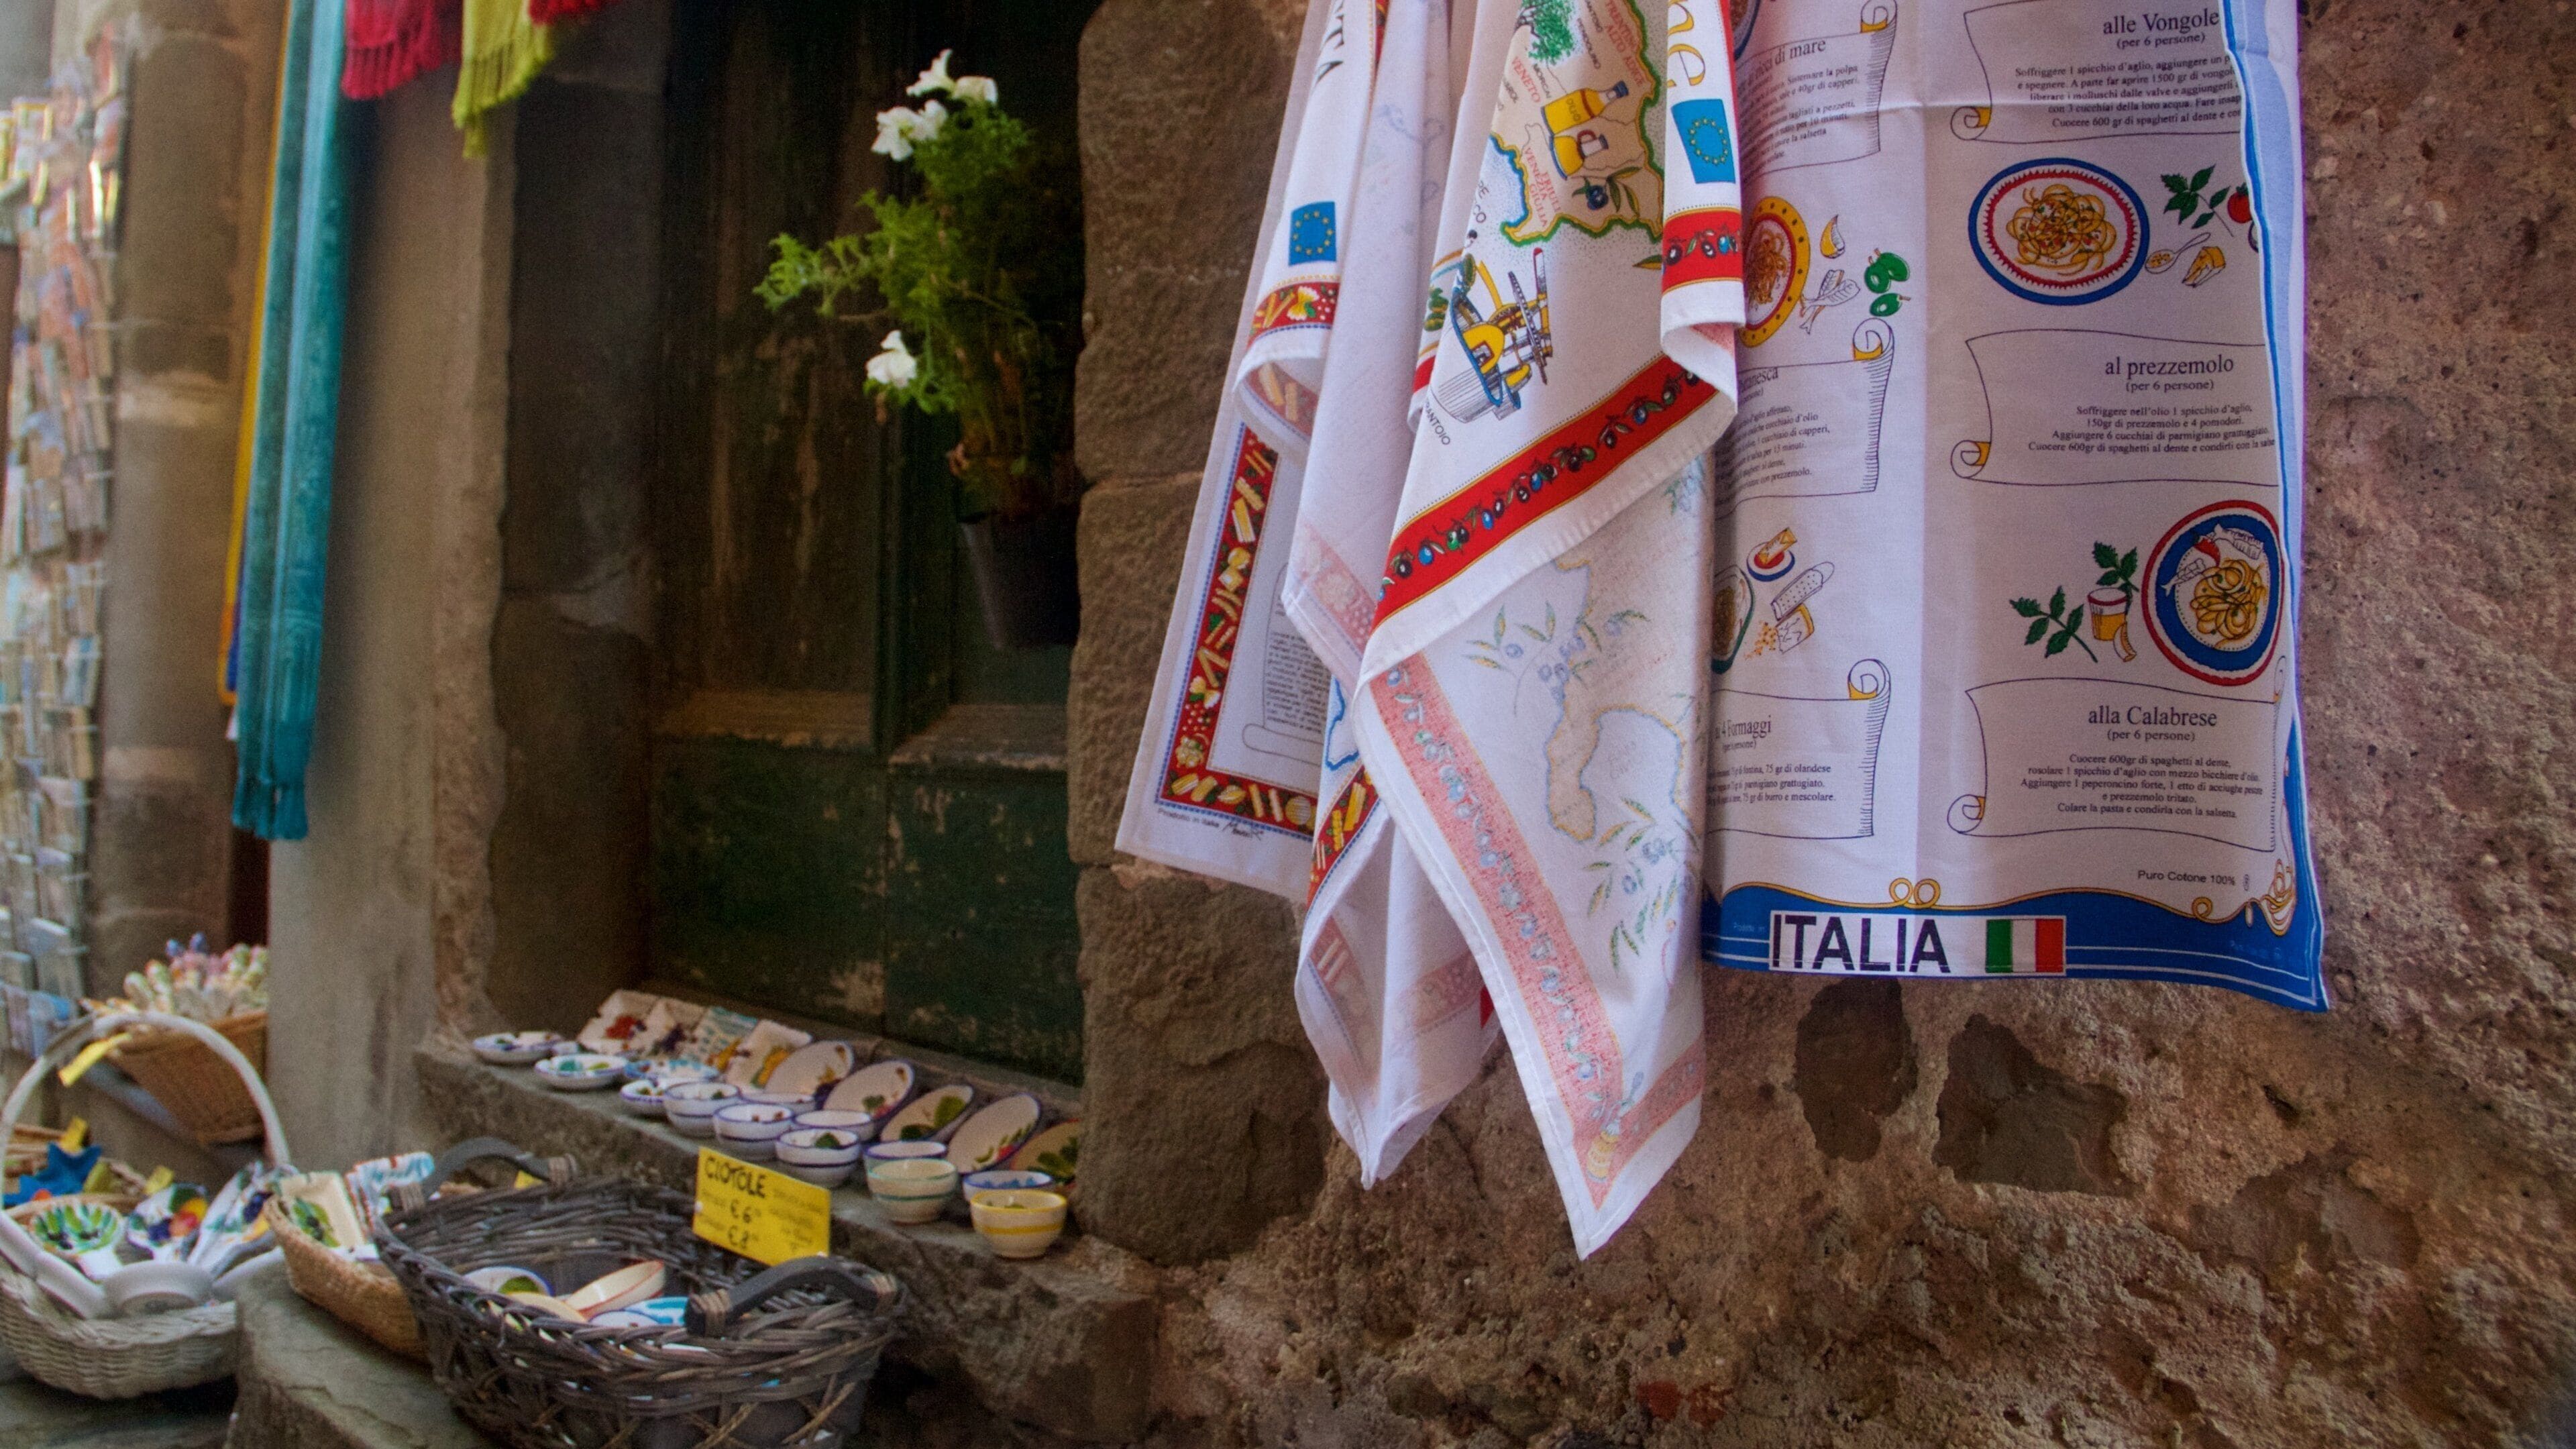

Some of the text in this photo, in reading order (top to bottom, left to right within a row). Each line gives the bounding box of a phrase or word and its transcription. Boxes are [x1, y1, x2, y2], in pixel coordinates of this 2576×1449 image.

[2103, 8, 2219, 34] alle Vongole
[2116, 34, 2206, 50] (per 6 persone)
[1775, 40, 1826, 66] di mare
[1835, 65, 1858, 77] polpa
[2015, 67, 2066, 78] Soffriggere
[2077, 62, 2116, 74] spicchio
[2156, 58, 2208, 70] aggiungere
[1511, 56, 1541, 103] VENETO
[2071, 79, 2078, 88] A
[2081, 79, 2104, 90] parte
[2106, 76, 2119, 85] far
[2122, 74, 2149, 87] aprire
[2153, 73, 2175, 83] 1500
[2178, 74, 2187, 84] gr
[2190, 71, 2198, 80] di
[2073, 89, 2118, 100] molluschi
[2121, 89, 2143, 99] dalle
[2146, 88, 2170, 97] valve
[2076, 103, 2114, 113] cucchiai
[2116, 101, 2139, 112] della
[2142, 101, 2160, 110] loro
[2196, 98, 2216, 107] Fare
[2052, 118, 2090, 127] Cuocere
[2092, 117, 2110, 126] 600
[2112, 119, 2123, 129] gr
[2125, 116, 2134, 125] di
[2137, 114, 2178, 126] spaghetti
[2181, 114, 2190, 123] al
[2192, 113, 2216, 122] dente
[2105, 354, 2235, 380] al prezzemolo
[2126, 379, 2214, 393] (per 6 persone)
[2076, 405, 2127, 417] Soffriggere
[2181, 405, 2219, 417] spicchio
[2114, 419, 2123, 428] di
[2126, 419, 2180, 430] prezzemolo
[2052, 430, 2220, 442] Aggiungere 6 cucchiai di parmigiano
[2029, 441, 2066, 451] Cuocere
[2068, 443, 2094, 454] 600gr
[2097, 443, 2106, 452] di
[2108, 443, 2149, 454] spaghetti
[2153, 443, 2161, 452] al
[2163, 443, 2189, 452] dente
[2088, 705, 2218, 727] alla Calabrese
[1727, 714, 1772, 739] Formaggi
[2107, 730, 2196, 743] (per 6 persone)
[2070, 753, 2106, 763] Cuocere
[2109, 755, 2137, 765] 600gr
[2138, 755, 2147, 764] di
[2151, 756, 2192, 767] spaghetti
[2195, 757, 2204, 766] al
[1784, 764, 1792, 773] di
[1794, 763, 1831, 773] olandese
[2028, 766, 2063, 775] rosolare
[2074, 766, 2111, 777] spicchio
[2113, 767, 2147, 778] d'aglio
[2169, 770, 2199, 778] mezzo
[2202, 769, 2239, 780] bicchiere
[2021, 777, 2072, 790] Aggiungere
[2082, 779, 2138, 790] peperoncino
[2178, 782, 2195, 790] etto
[2197, 782, 2206, 791] di
[2209, 784, 2242, 796] acciughe
[1757, 793, 1764, 802] di
[1765, 792, 1782, 802] burro
[2110, 793, 2164, 802] prezzemolo
[2057, 802, 2087, 812] Colare
[2090, 803, 2098, 812] la
[2100, 805, 2124, 814] pasta
[2135, 804, 2173, 814] condirla
[2176, 808, 2192, 816] con
[2195, 806, 2203, 816] la
[2137, 869, 2235, 886] Puro Cotone 100%
[1773, 914, 1951, 973] ITALIA
